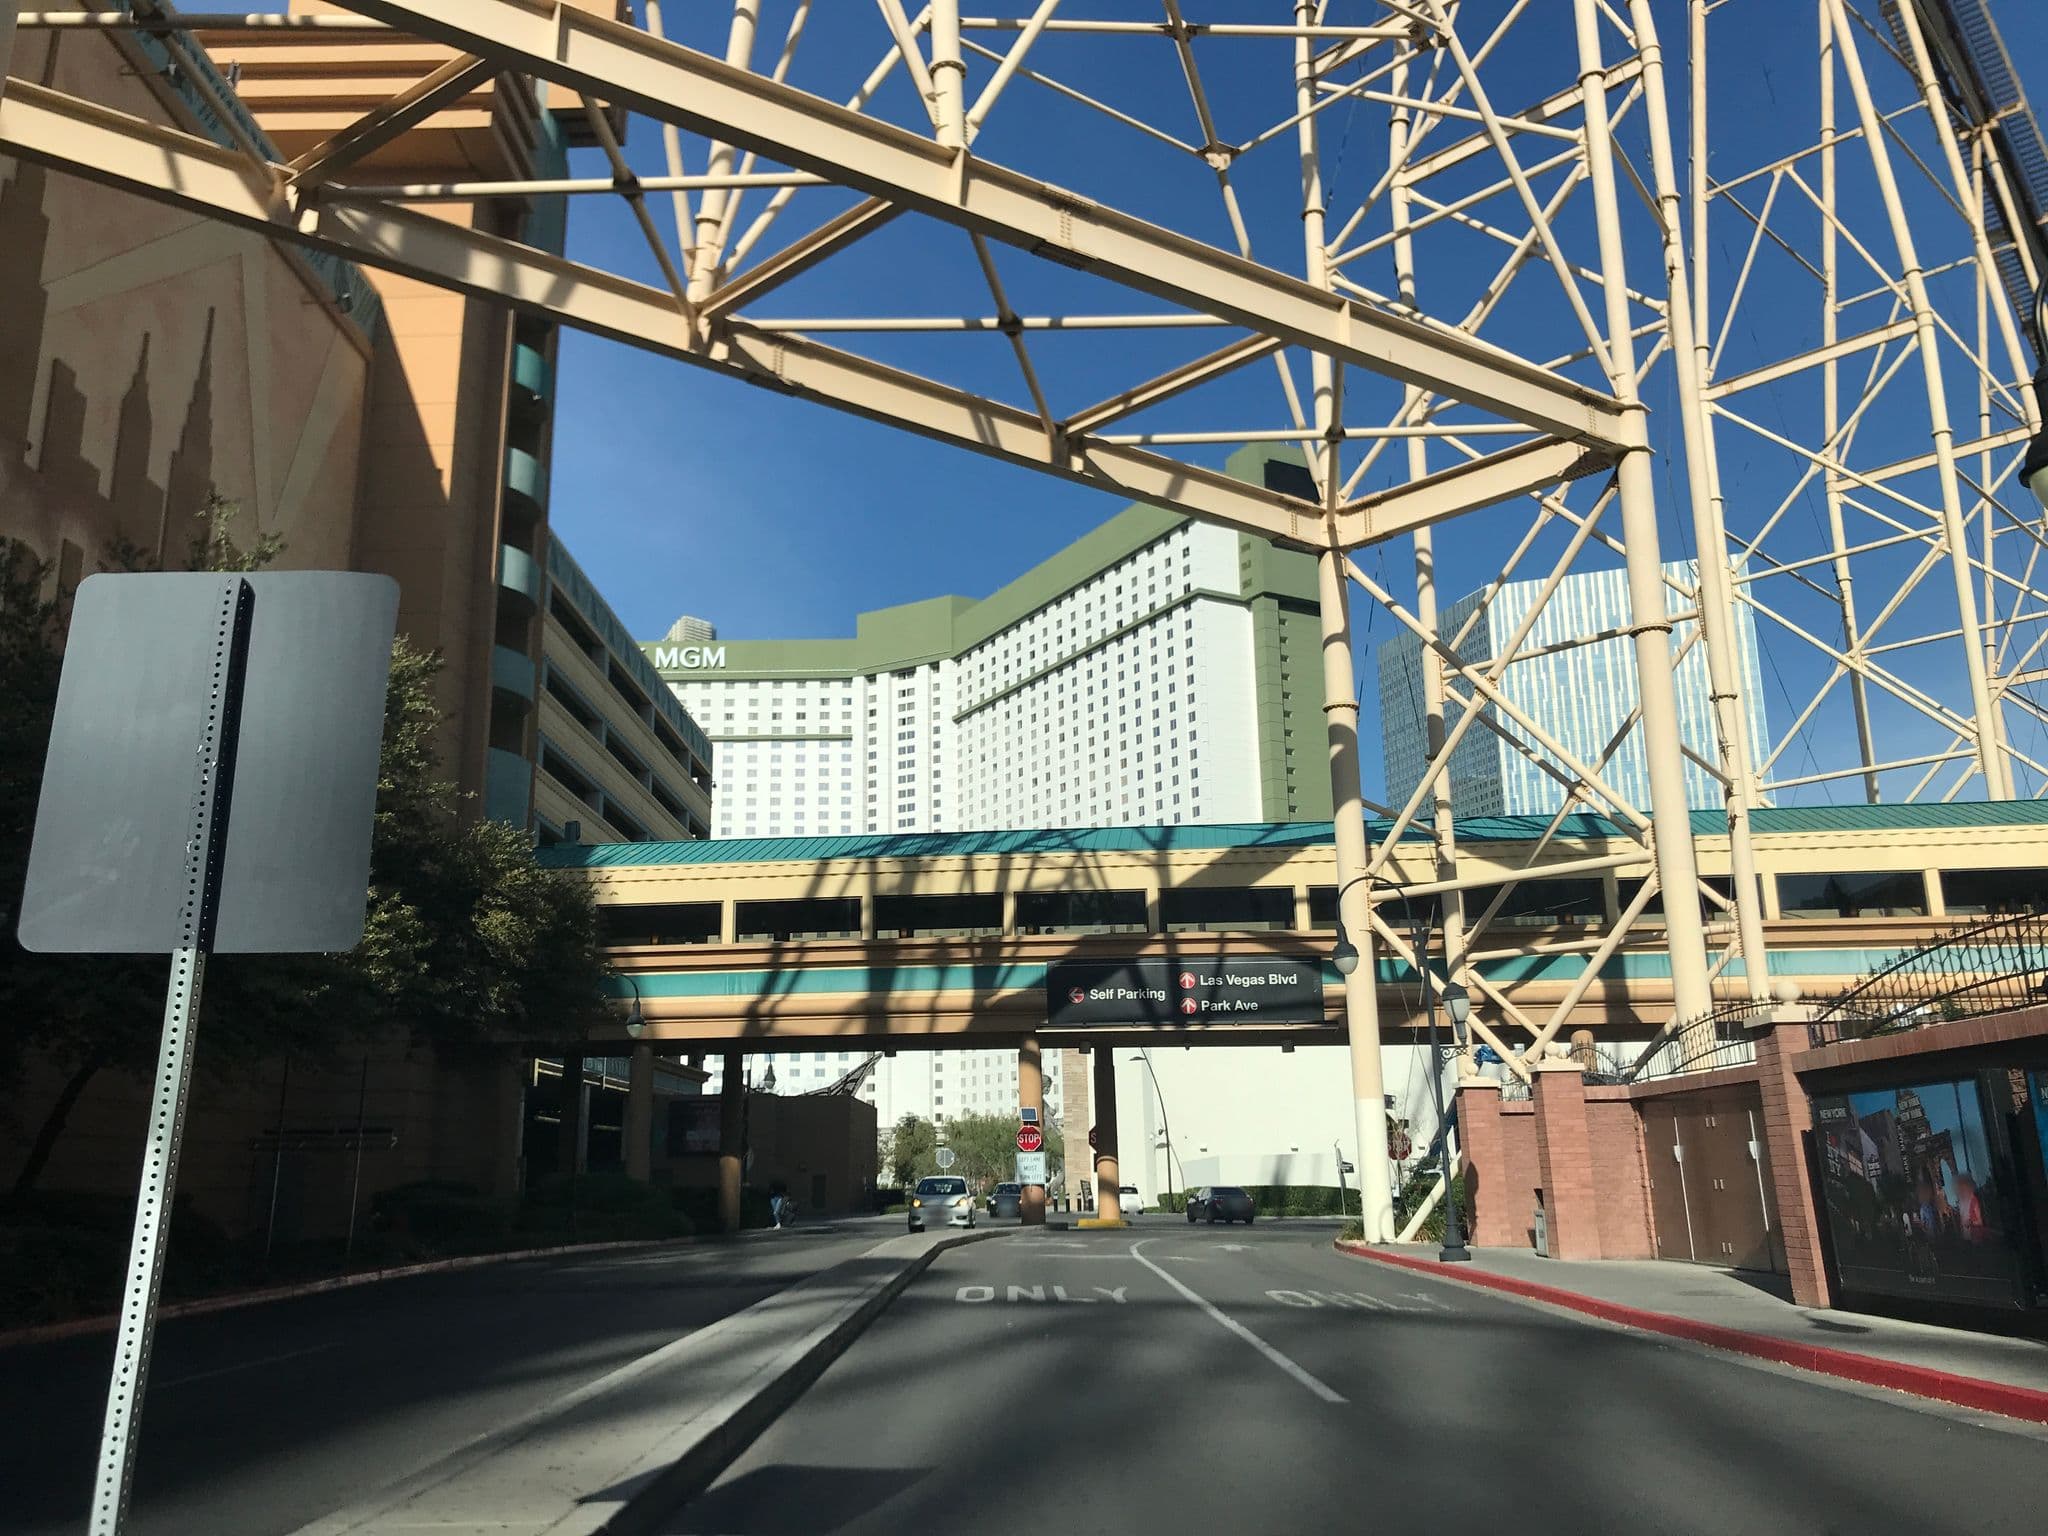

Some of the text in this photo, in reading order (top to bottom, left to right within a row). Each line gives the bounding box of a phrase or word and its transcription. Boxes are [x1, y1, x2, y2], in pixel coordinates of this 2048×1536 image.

[655, 646, 727, 669] MGM
[1200, 973, 1298, 988] Las Vegas Blvd
[1089, 988, 1166, 1001] Self Parking
[1201, 1000, 1259, 1012] Park Ave
[1018, 1133, 1040, 1143] STOP
[954, 1284, 1129, 1304] ONLY
[1264, 1290, 1454, 1312] ONLY
